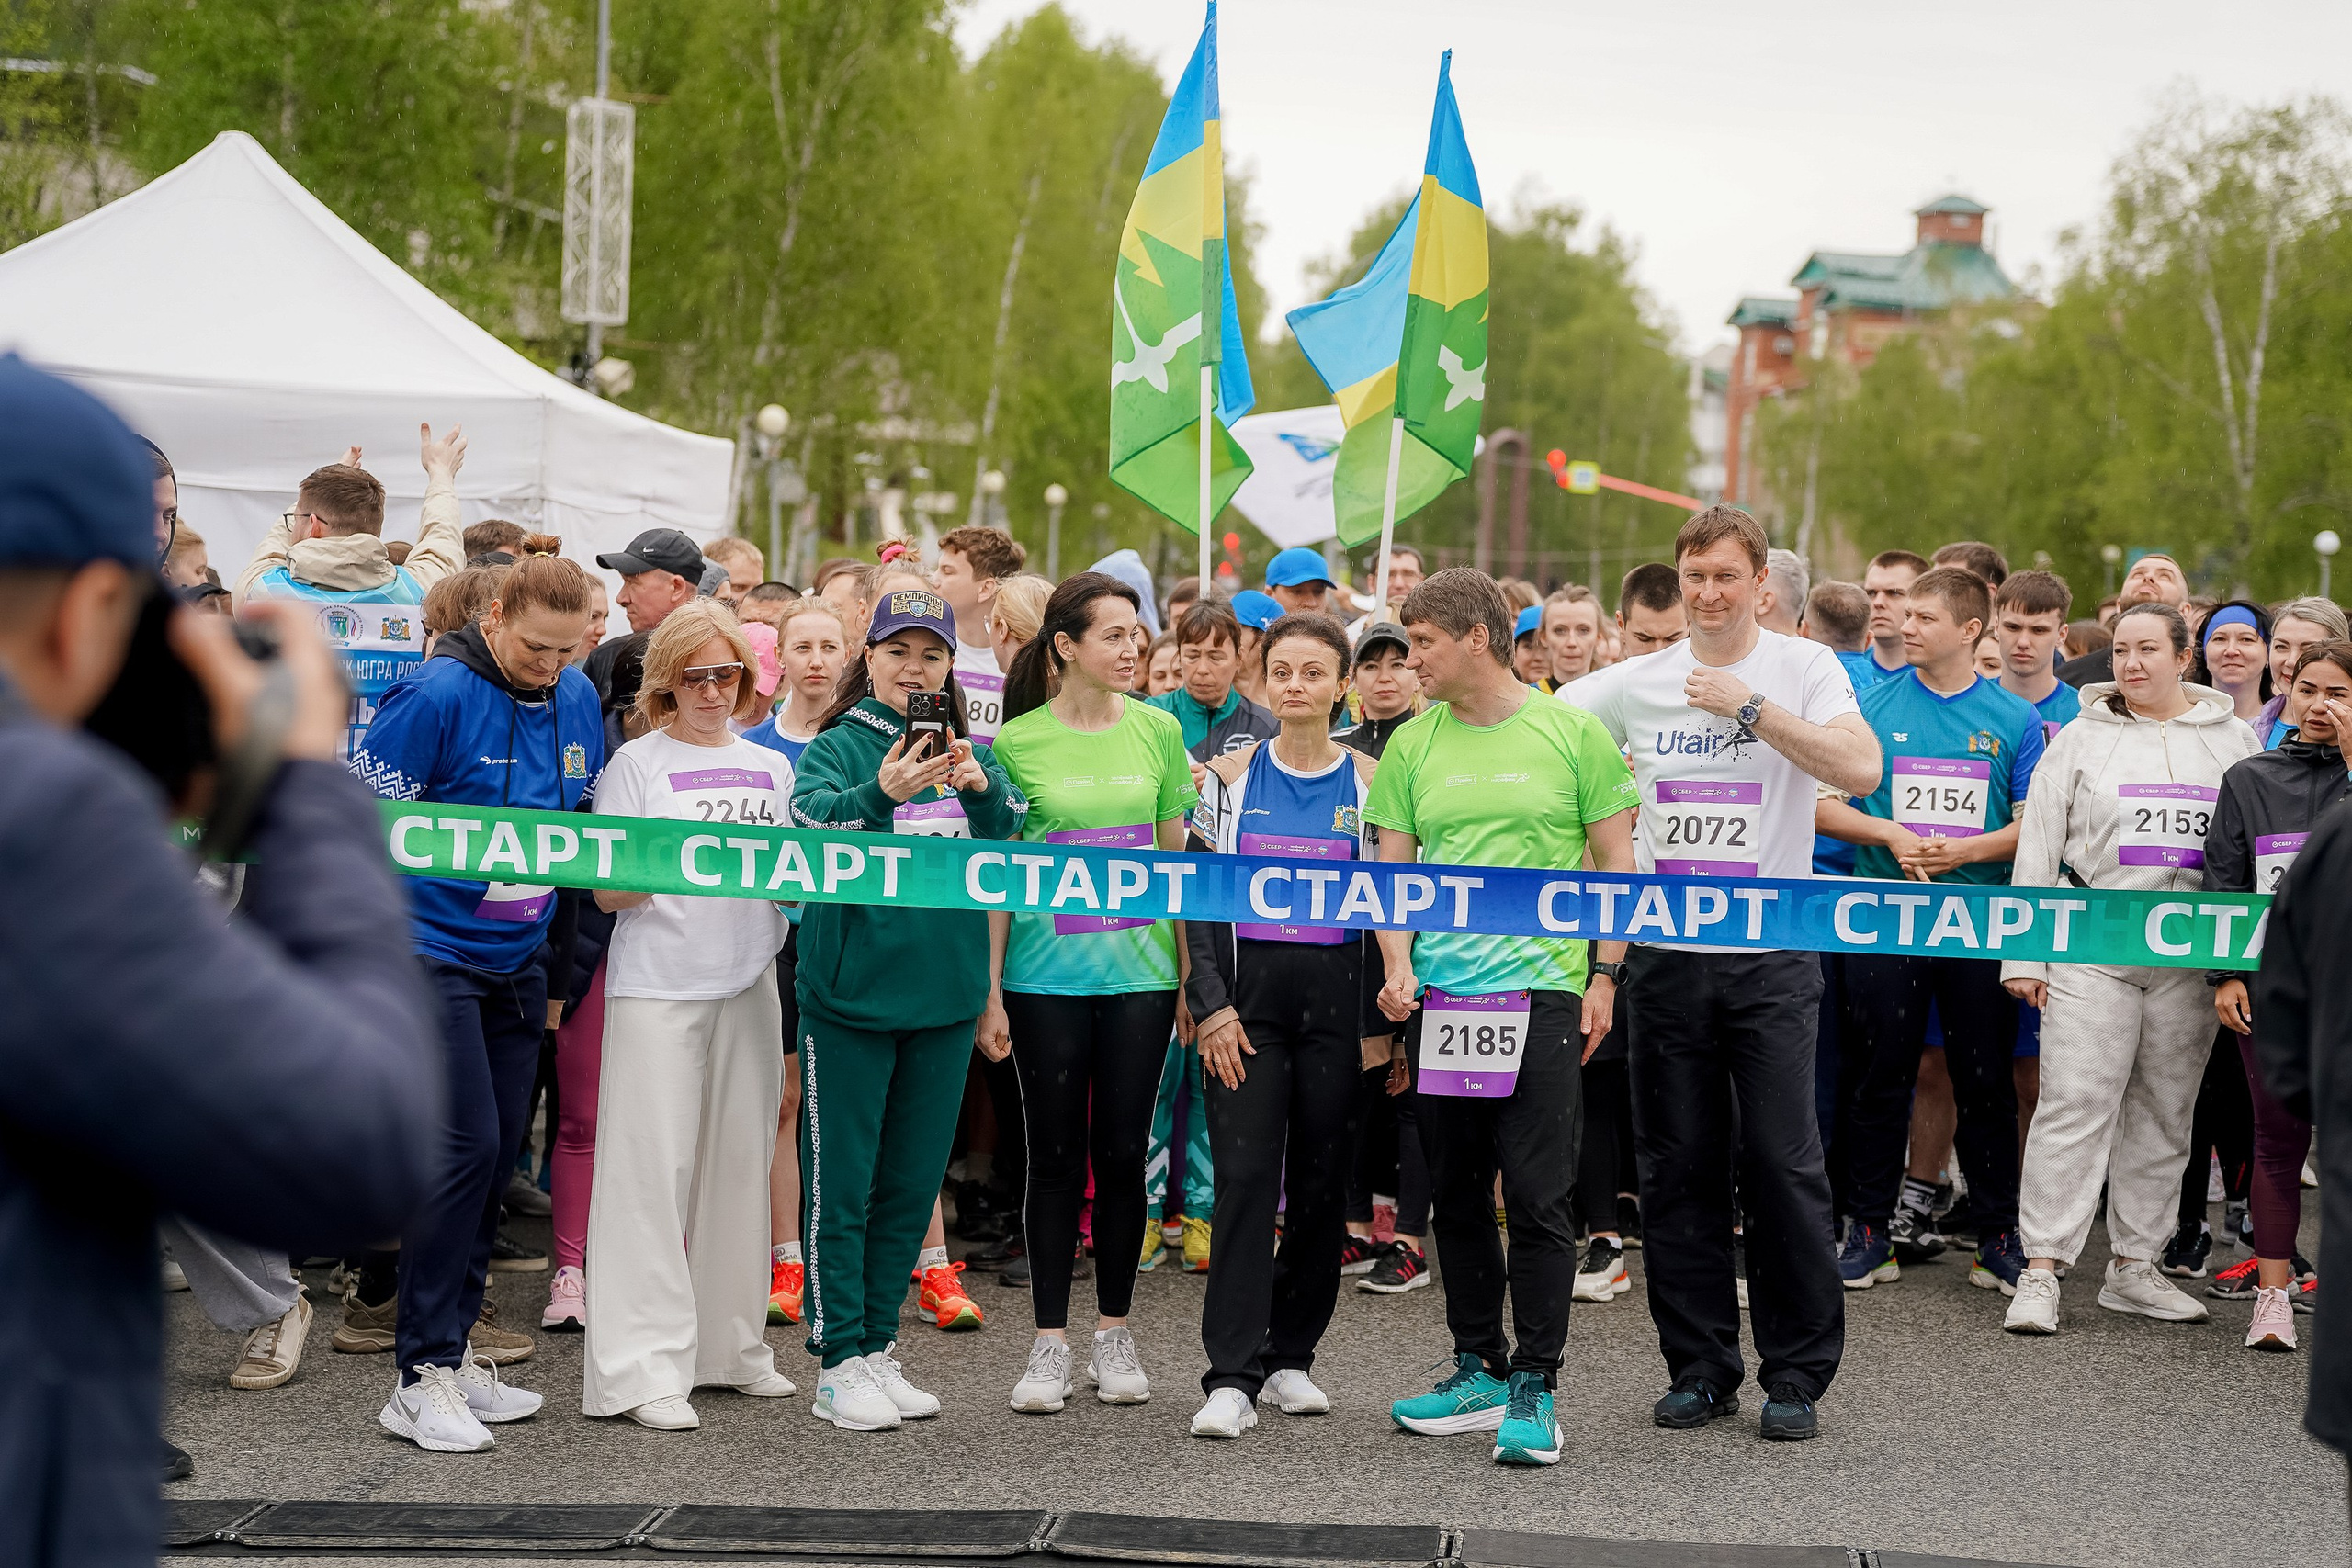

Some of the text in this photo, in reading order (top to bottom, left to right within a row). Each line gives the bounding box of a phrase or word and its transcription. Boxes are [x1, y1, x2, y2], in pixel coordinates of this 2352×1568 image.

[893, 592, 942, 607] ЧЕМПИОНЫ
[357, 660, 393, 680] ЮГРА
[1656, 728, 1724, 755] Utair
[696, 798, 775, 825] 2244
[1905, 786, 1976, 815] 2154
[1666, 815, 1747, 847] 2072
[2134, 808, 2211, 837] 2153
[390, 815, 627, 880] СТАРТ
[680, 833, 912, 897] СТАРТ
[965, 852, 1197, 915] СТАРТ
[1250, 866, 1484, 929] СТАРТ
[1536, 881, 1779, 941] СТАРТ
[1834, 892, 2087, 952] СТАРТ
[1438, 1024, 1517, 1056] 2185
